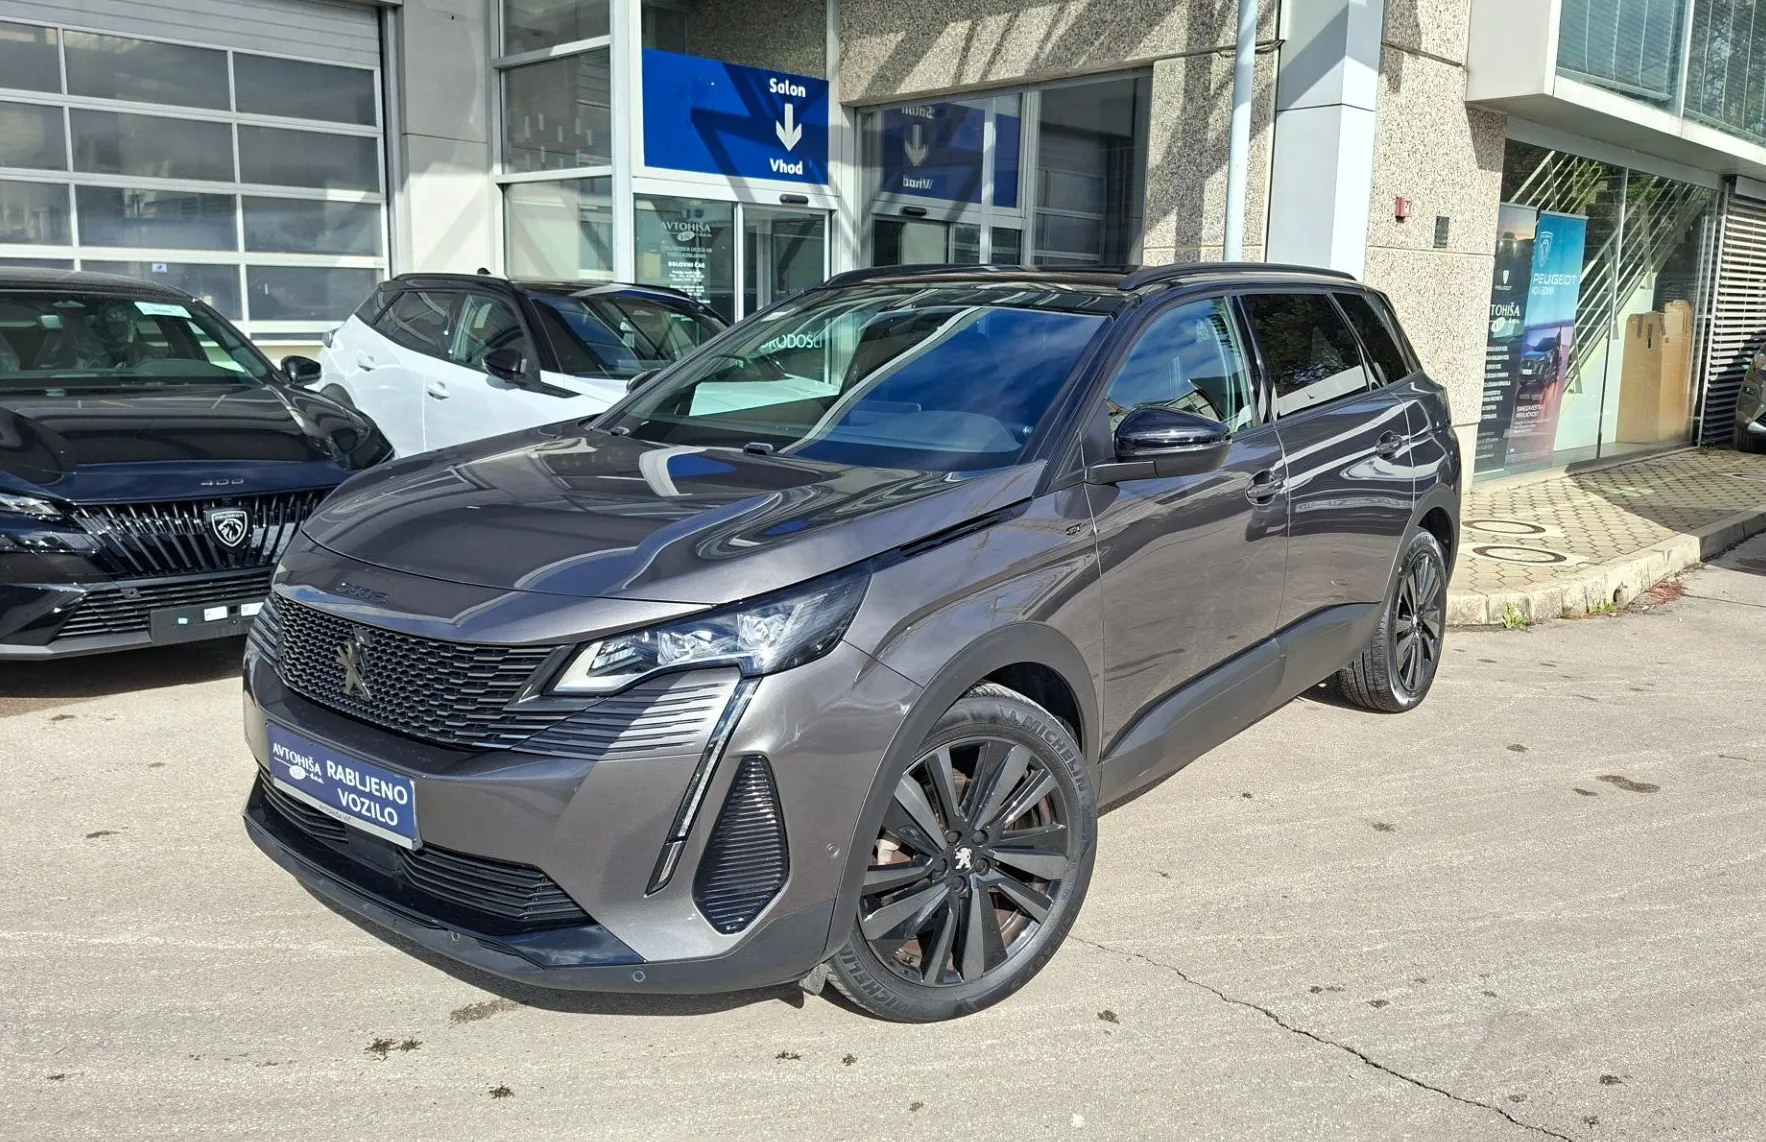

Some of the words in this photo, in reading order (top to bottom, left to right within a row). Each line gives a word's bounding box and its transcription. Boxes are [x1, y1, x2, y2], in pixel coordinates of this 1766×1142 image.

[769, 78, 806, 97] Salon
[769, 158, 803, 175] Vhod
[1532, 272, 1578, 286] PEUGEOT
[1491, 301, 1520, 316] TOHIŠA
[1022, 714, 1086, 793] MICHELIN
[273, 742, 321, 776] AVTOHIŠA
[326, 759, 408, 805] RABLJENO
[337, 788, 398, 826] VOZILO
